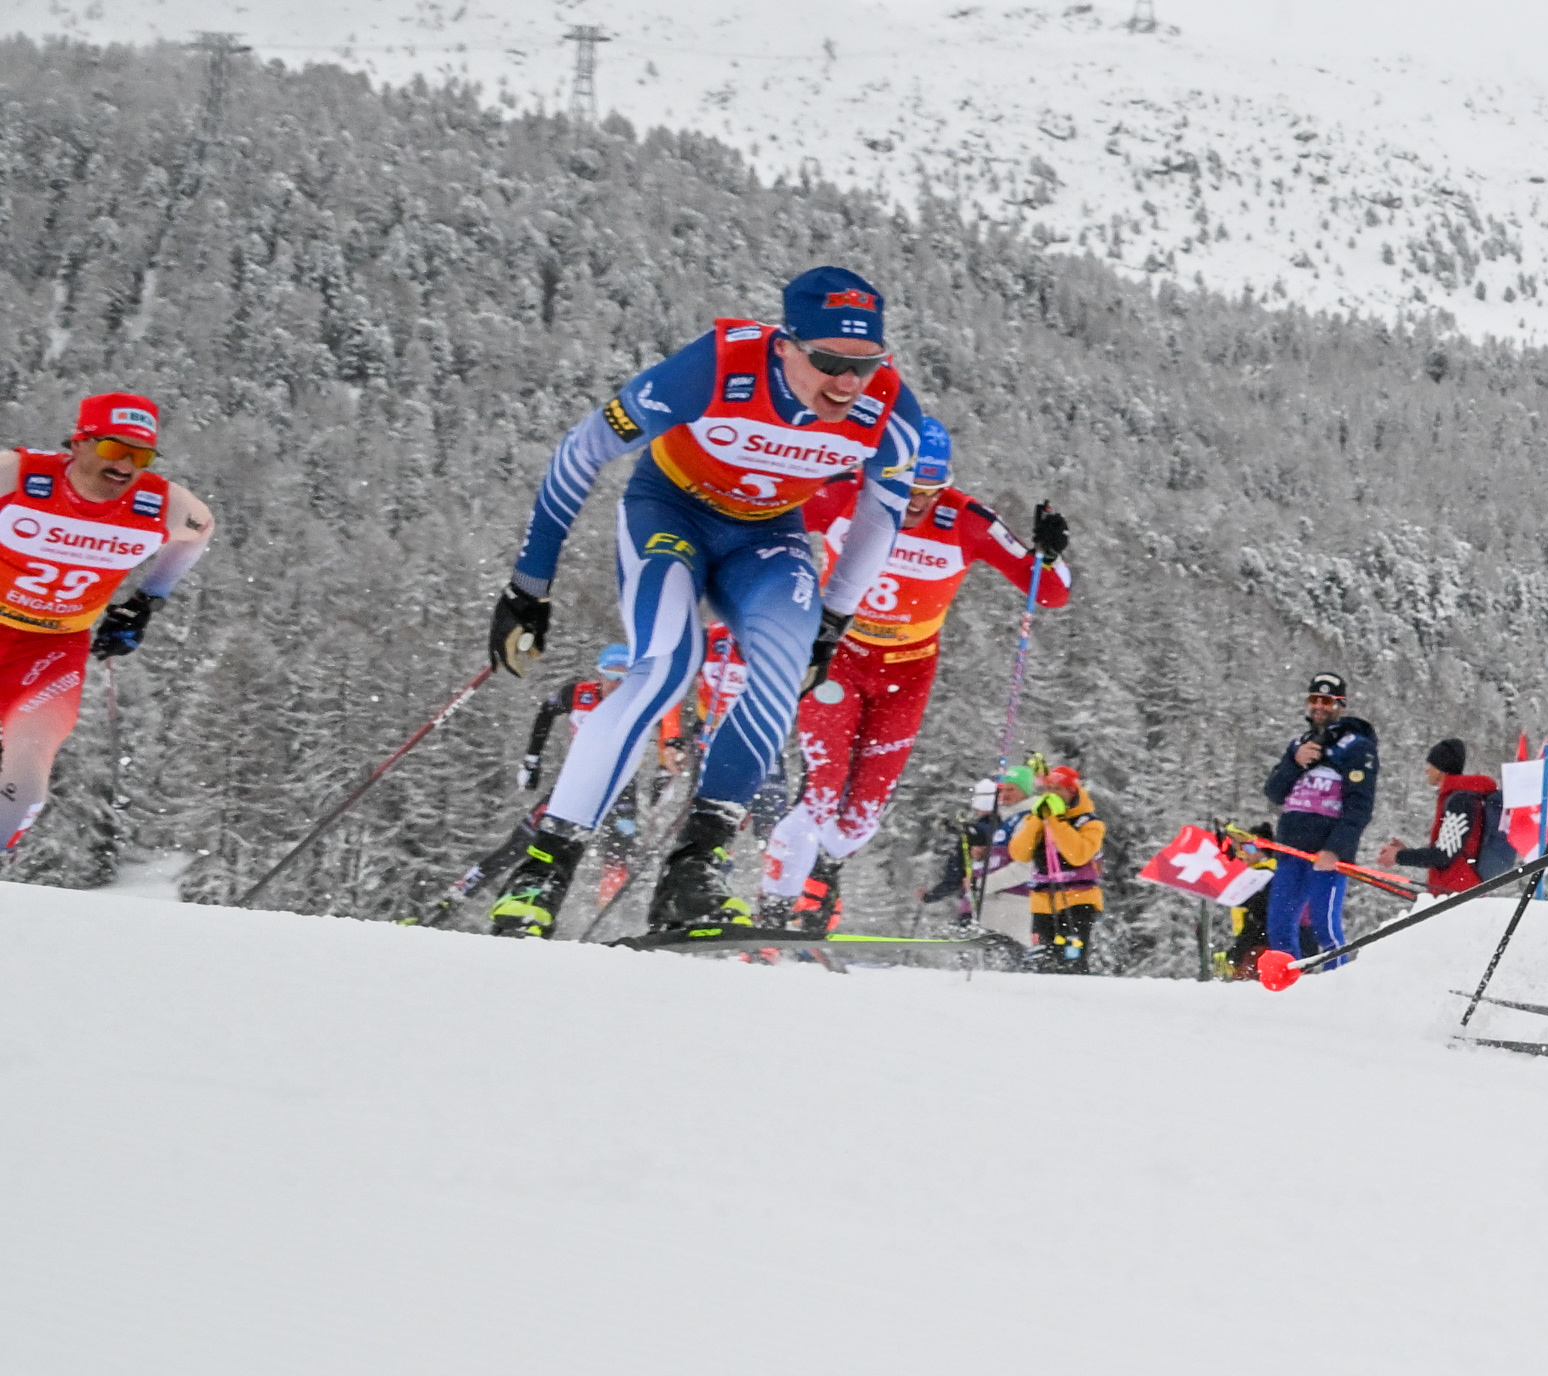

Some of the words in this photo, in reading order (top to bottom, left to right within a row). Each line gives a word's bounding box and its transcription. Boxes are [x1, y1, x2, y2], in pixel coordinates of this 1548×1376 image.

[743, 434, 858, 466] Sunrise
[45, 526, 146, 556] Sunrise
[14, 561, 101, 600] 29
[865, 576, 900, 612] 8
